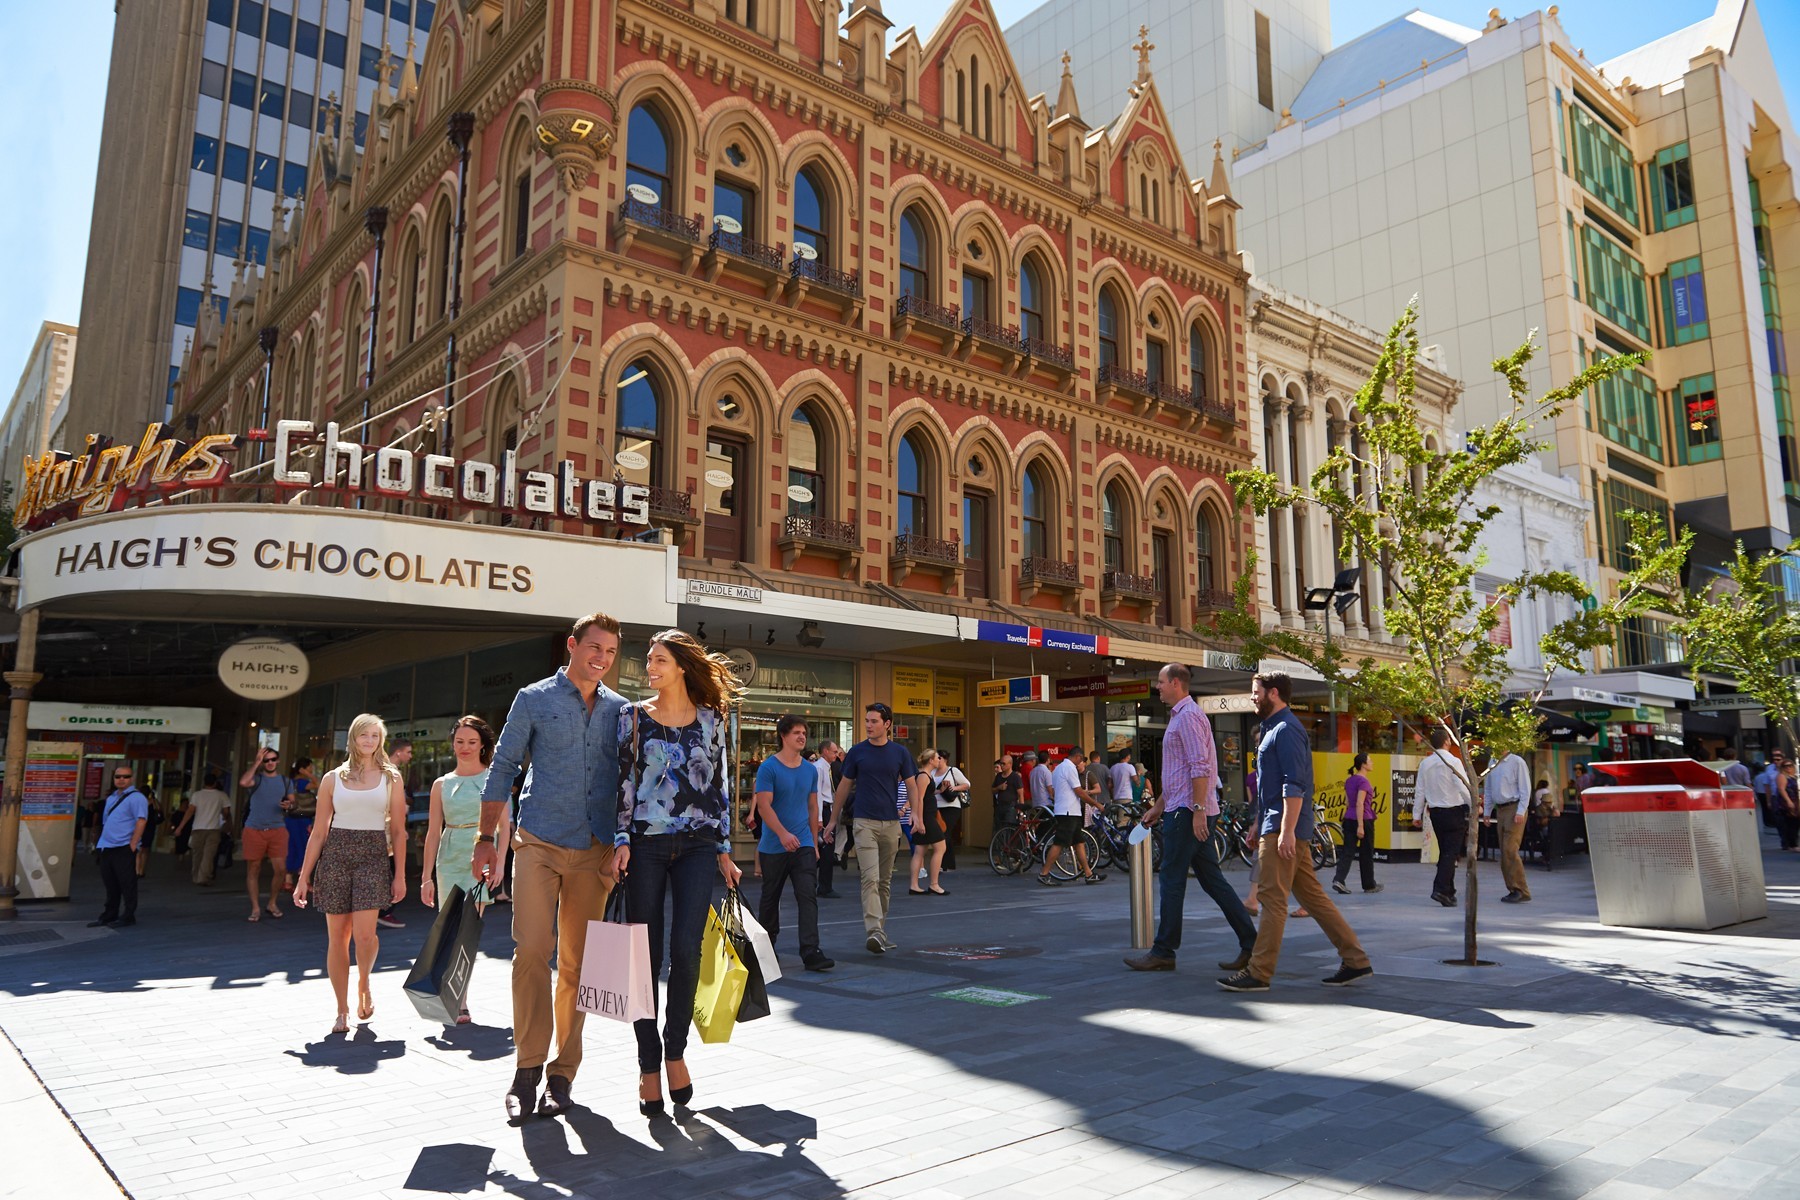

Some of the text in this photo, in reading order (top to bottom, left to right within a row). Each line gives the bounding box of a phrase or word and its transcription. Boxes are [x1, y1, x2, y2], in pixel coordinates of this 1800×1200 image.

[274, 419, 650, 526] Chocolates
[54, 536, 534, 594] HAIGH'S CHOCOLATES
[699, 583, 759, 600] RUNDLE MALL
[1006, 633, 1028, 644] Travelex
[1047, 639, 1095, 653] Currency Exchange
[232, 661, 300, 675] HAIGH'S
[240, 682, 289, 691] CHOCOLATES
[768, 682, 827, 698] HAIGH'S
[1090, 681, 1105, 690] atm
[68, 716, 164, 726] OPALS GIFTS
[577, 984, 629, 1018] REVIEW
